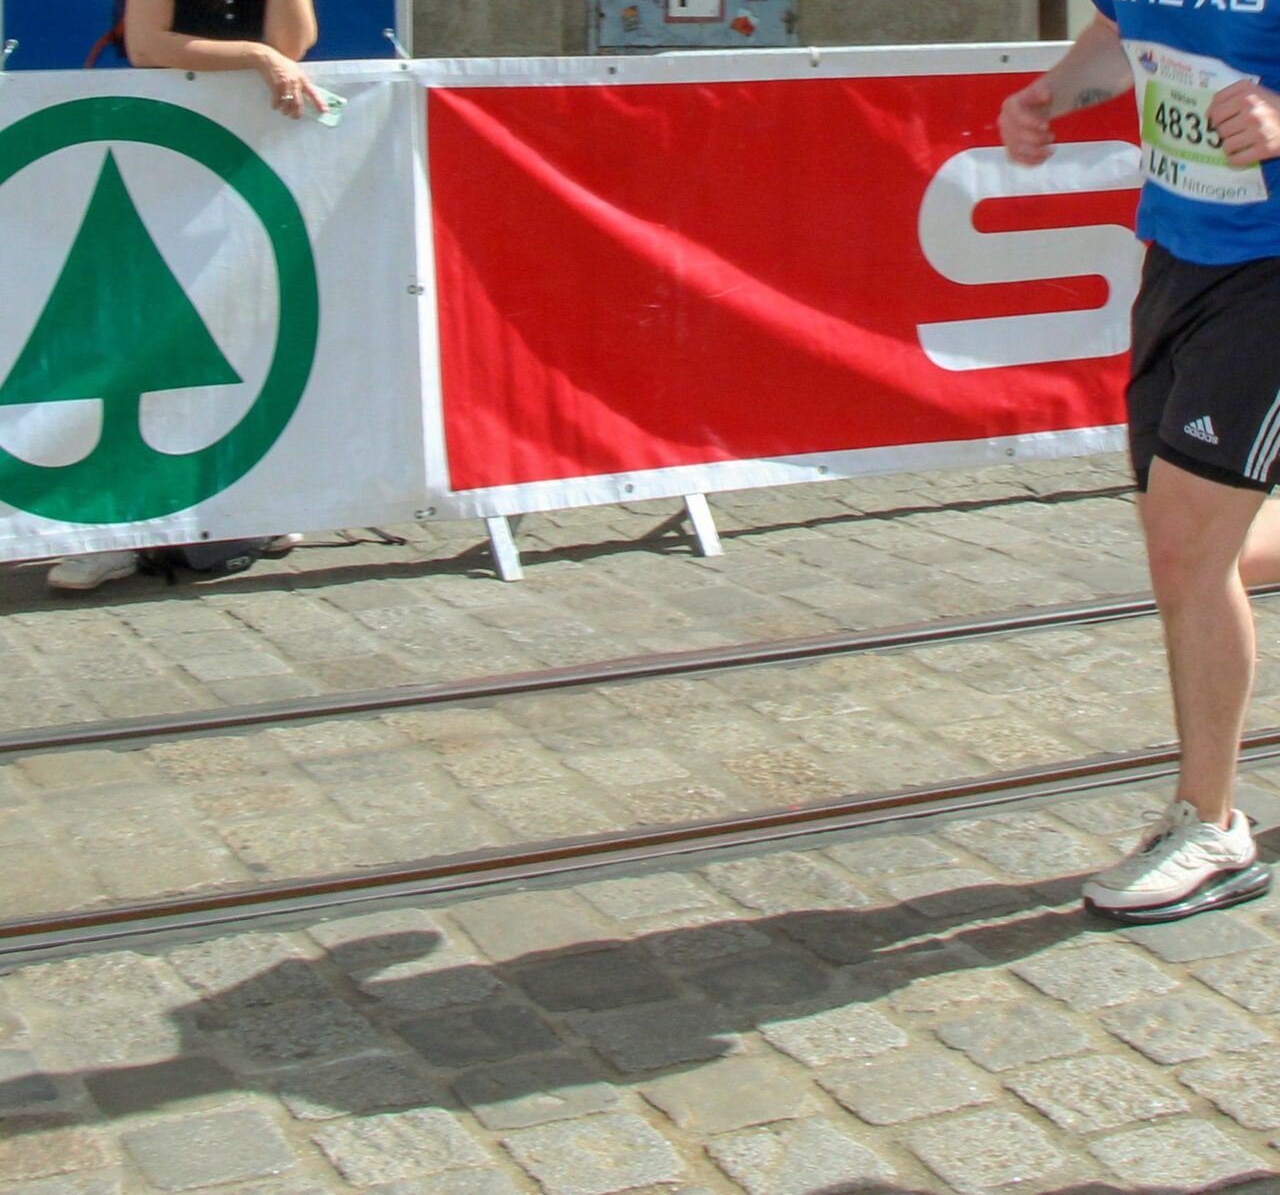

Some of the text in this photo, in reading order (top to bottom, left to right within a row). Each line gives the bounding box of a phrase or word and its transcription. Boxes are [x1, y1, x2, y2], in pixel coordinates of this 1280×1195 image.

[1149, 147, 1180, 185] LAT
[1181, 176, 1248, 199] Nitrogen
[1183, 424, 1219, 445] adidas
